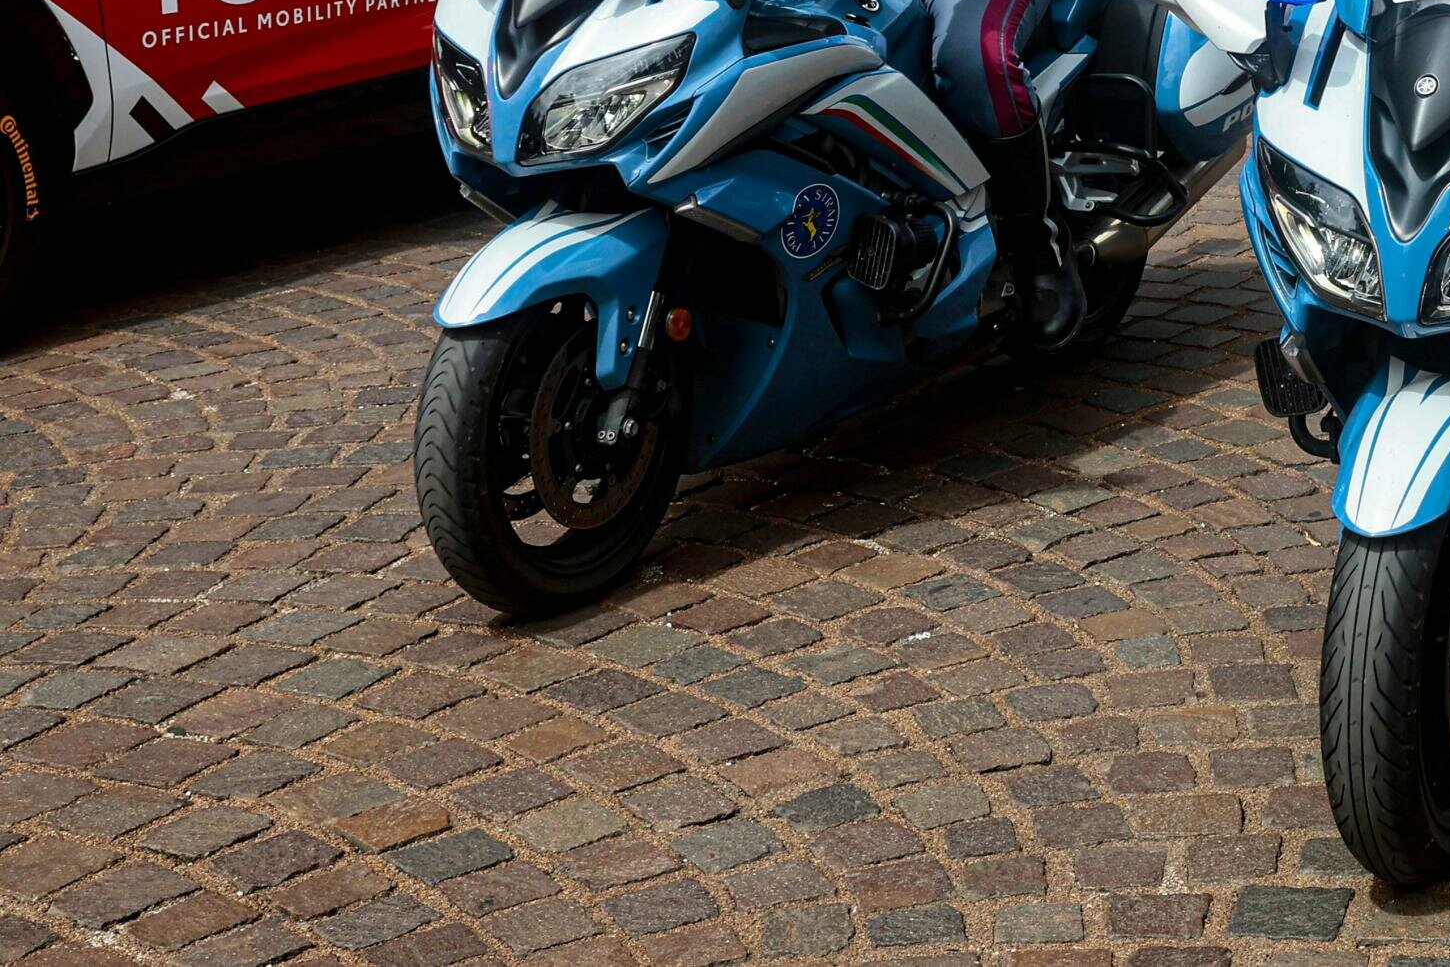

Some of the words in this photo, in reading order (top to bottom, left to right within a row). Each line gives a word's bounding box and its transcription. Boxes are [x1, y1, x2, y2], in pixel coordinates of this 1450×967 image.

[142, 18, 248, 49] OFFICIAL
[257, 0, 357, 30] MOBILITY
[0, 115, 39, 206] Continental
